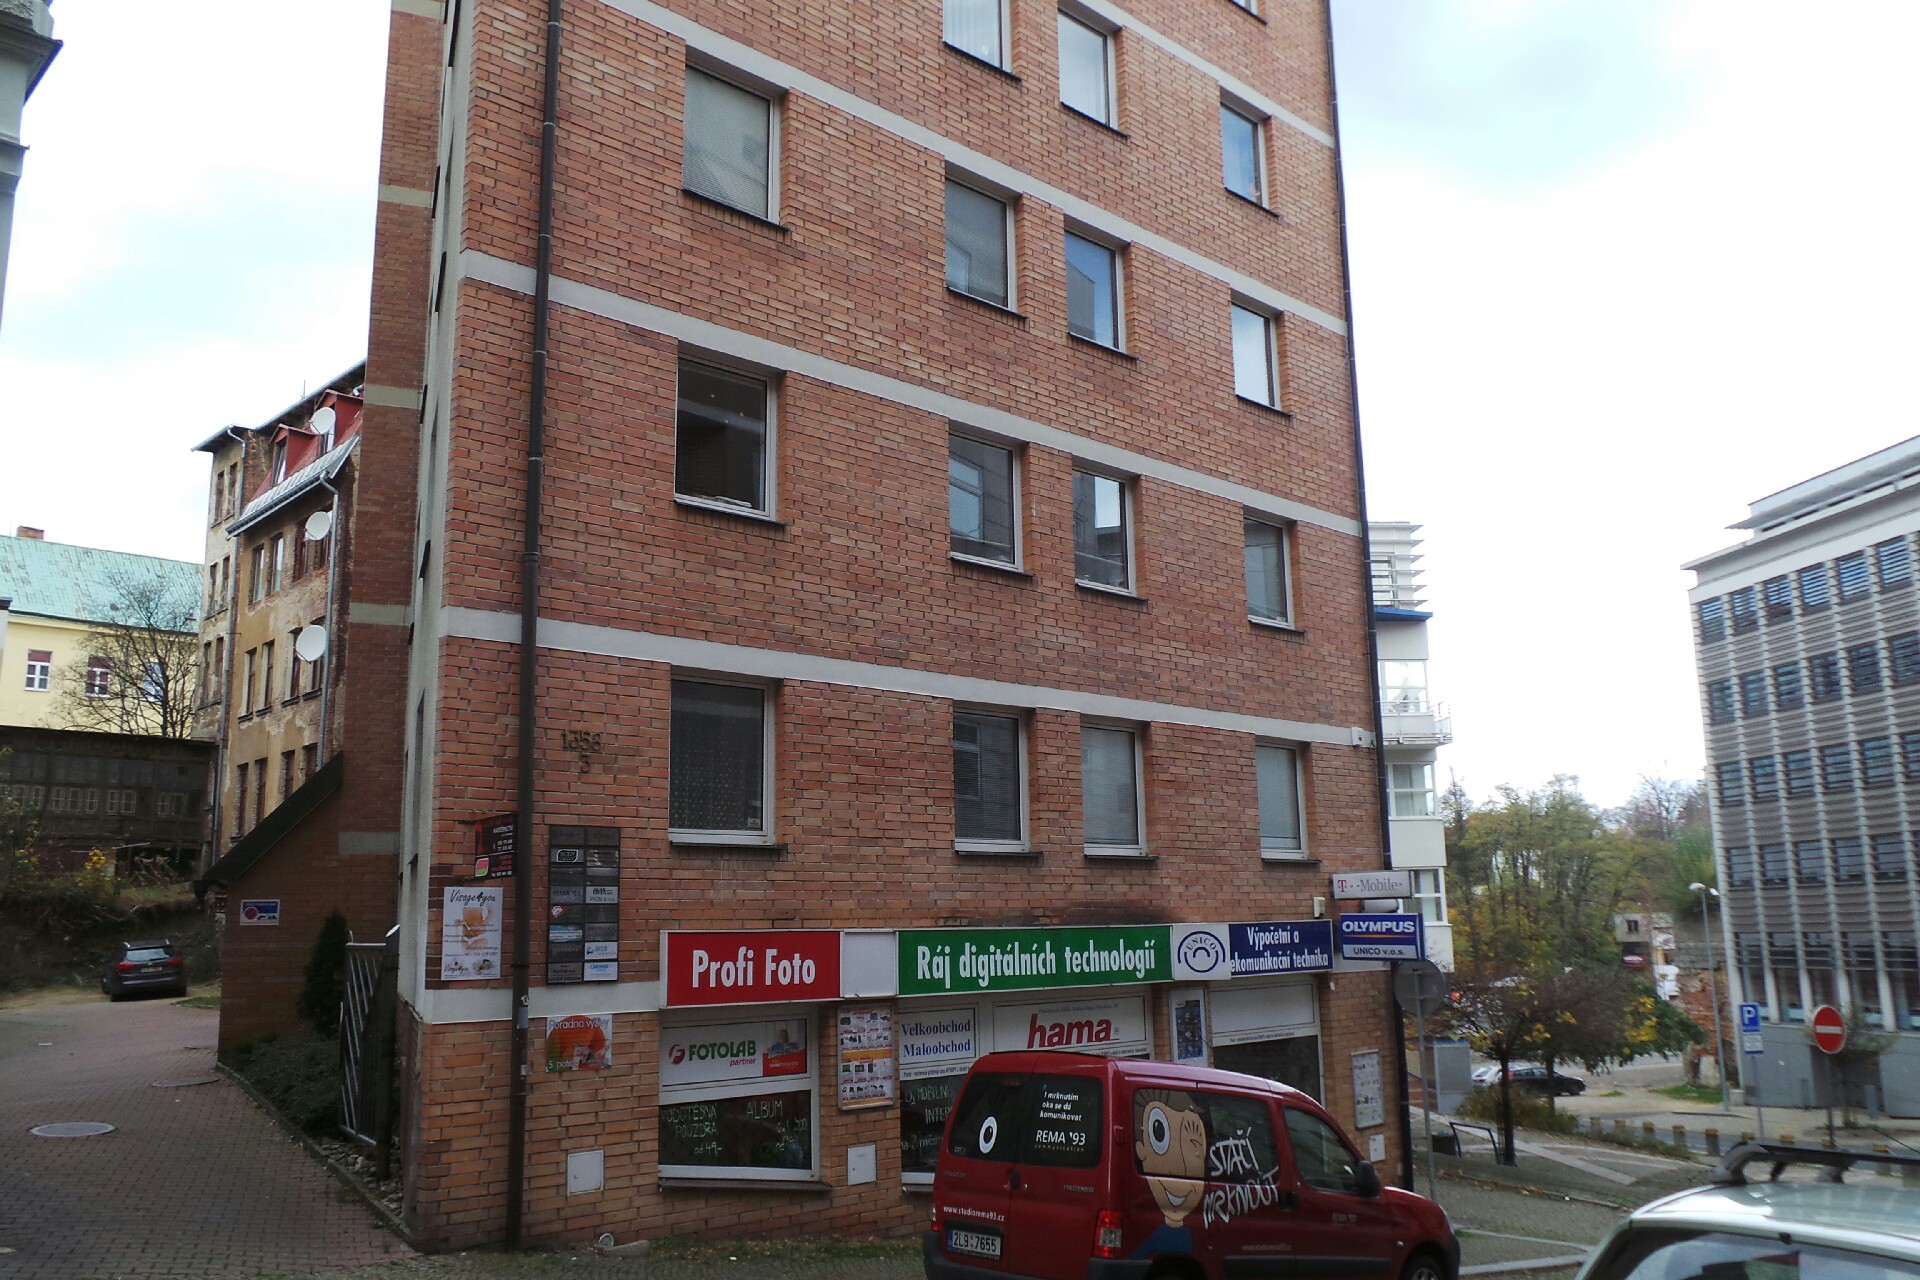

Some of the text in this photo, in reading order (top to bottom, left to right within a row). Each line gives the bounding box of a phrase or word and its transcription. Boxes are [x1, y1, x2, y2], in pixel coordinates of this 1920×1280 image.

[1342, 921, 1415, 933] OLYMPUS
[1185, 936, 1218, 950] UNICO
[1247, 925, 1300, 951] Výpočetní a
[1293, 947, 1329, 970] technika
[1353, 947, 1381, 956] UNICO
[692, 946, 817, 988] Profi Foto
[917, 938, 1155, 990] Ráj digitálních technologií
[548, 1018, 584, 1031] Poradna
[1743, 1006, 1756, 1025] P
[901, 1020, 971, 1036] Velkoobchod
[1027, 1013, 1112, 1049] hama
[689, 1040, 757, 1062] FOTOLAB
[903, 1039, 971, 1058] Maloobchod
[729, 1058, 757, 1068] partner
[746, 1100, 783, 1119] ALBUM
[1042, 1101, 1053, 1109] oka
[1039, 1110, 1083, 1122] komunikovat
[675, 1121, 718, 1138] POUZDRA
[1035, 1129, 1087, 1146] REMA '93
[1209, 1127, 1258, 1176] STAČÍ
[1203, 1166, 1279, 1229] MRKNOUT
[942, 1204, 1006, 1222] www.studiorema93.cz
[953, 1231, 997, 1252] 2L9 7655
